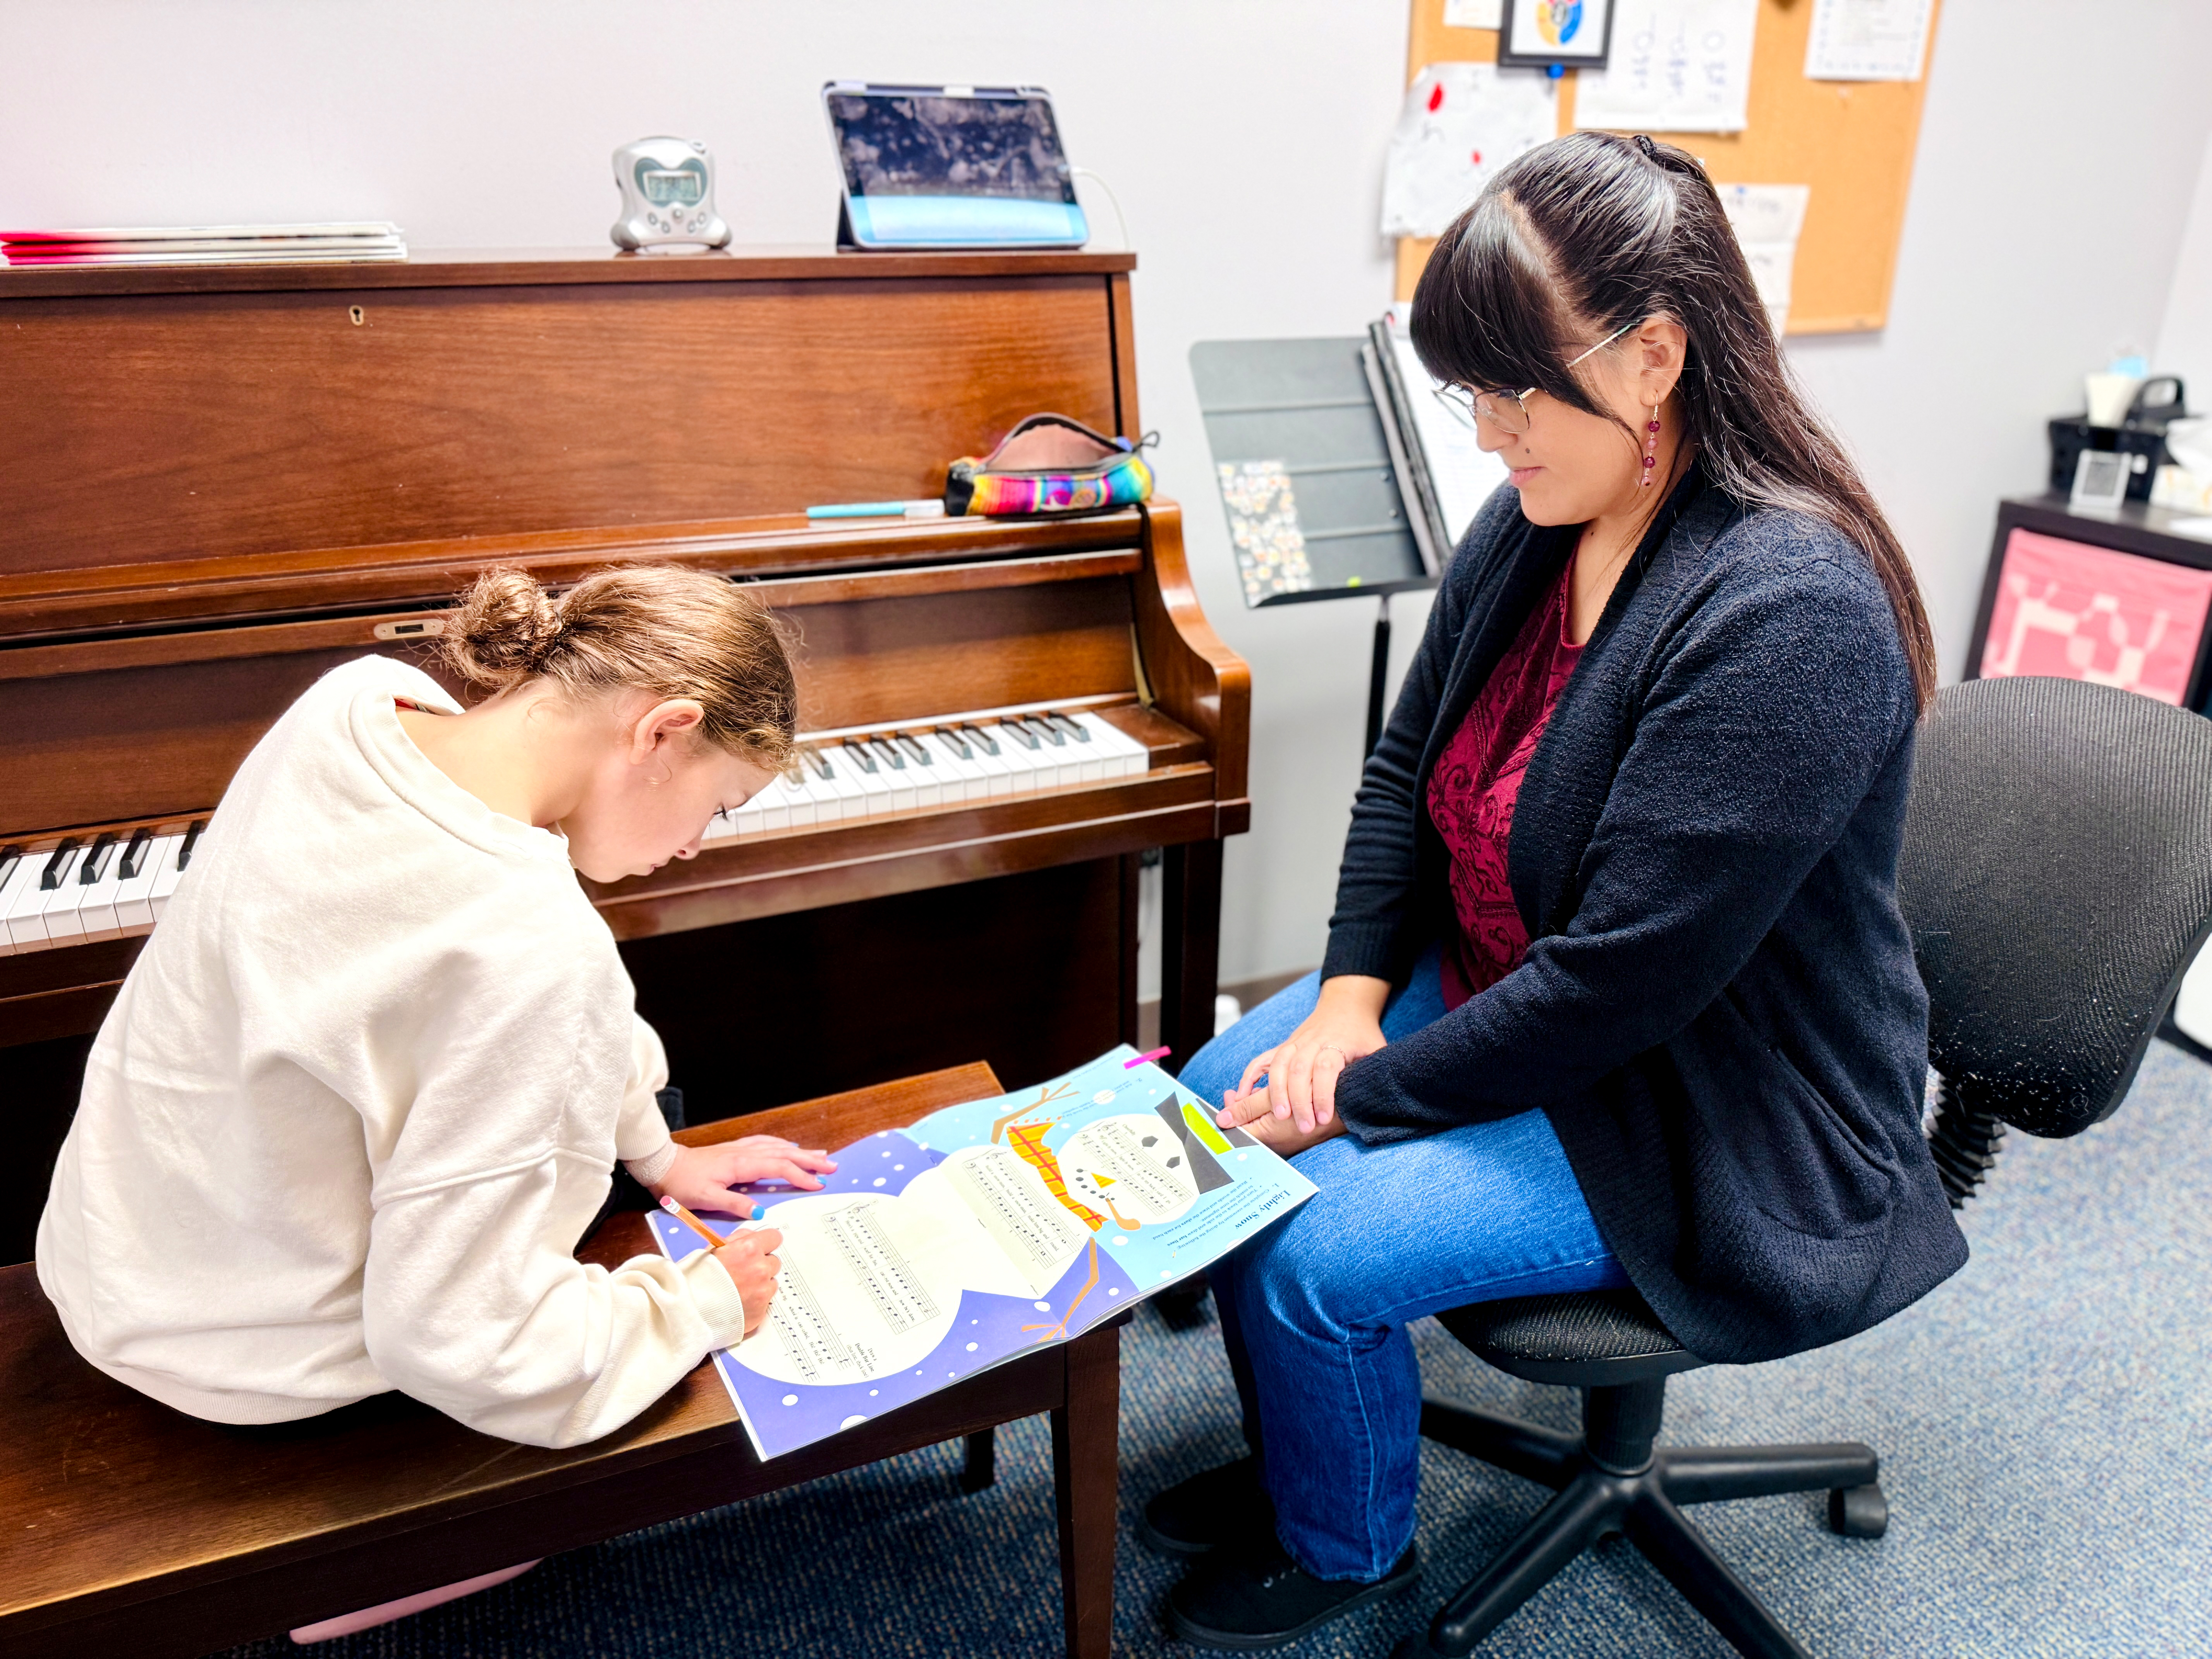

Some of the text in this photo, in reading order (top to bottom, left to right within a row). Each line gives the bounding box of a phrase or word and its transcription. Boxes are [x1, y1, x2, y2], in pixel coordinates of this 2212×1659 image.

[1236, 1180, 1248, 1189] Read
[1236, 1188, 1249, 1198] match
[1250, 1189, 1269, 1203] Complete
[1217, 1194, 1230, 1202] words
[1237, 1195, 1247, 1204] your
[1199, 1207, 1210, 1215] trace
[1224, 1207, 1243, 1221] snowman
[1235, 1190, 1291, 1229] Lightly Snow
[1205, 1224, 1218, 1233] doing
